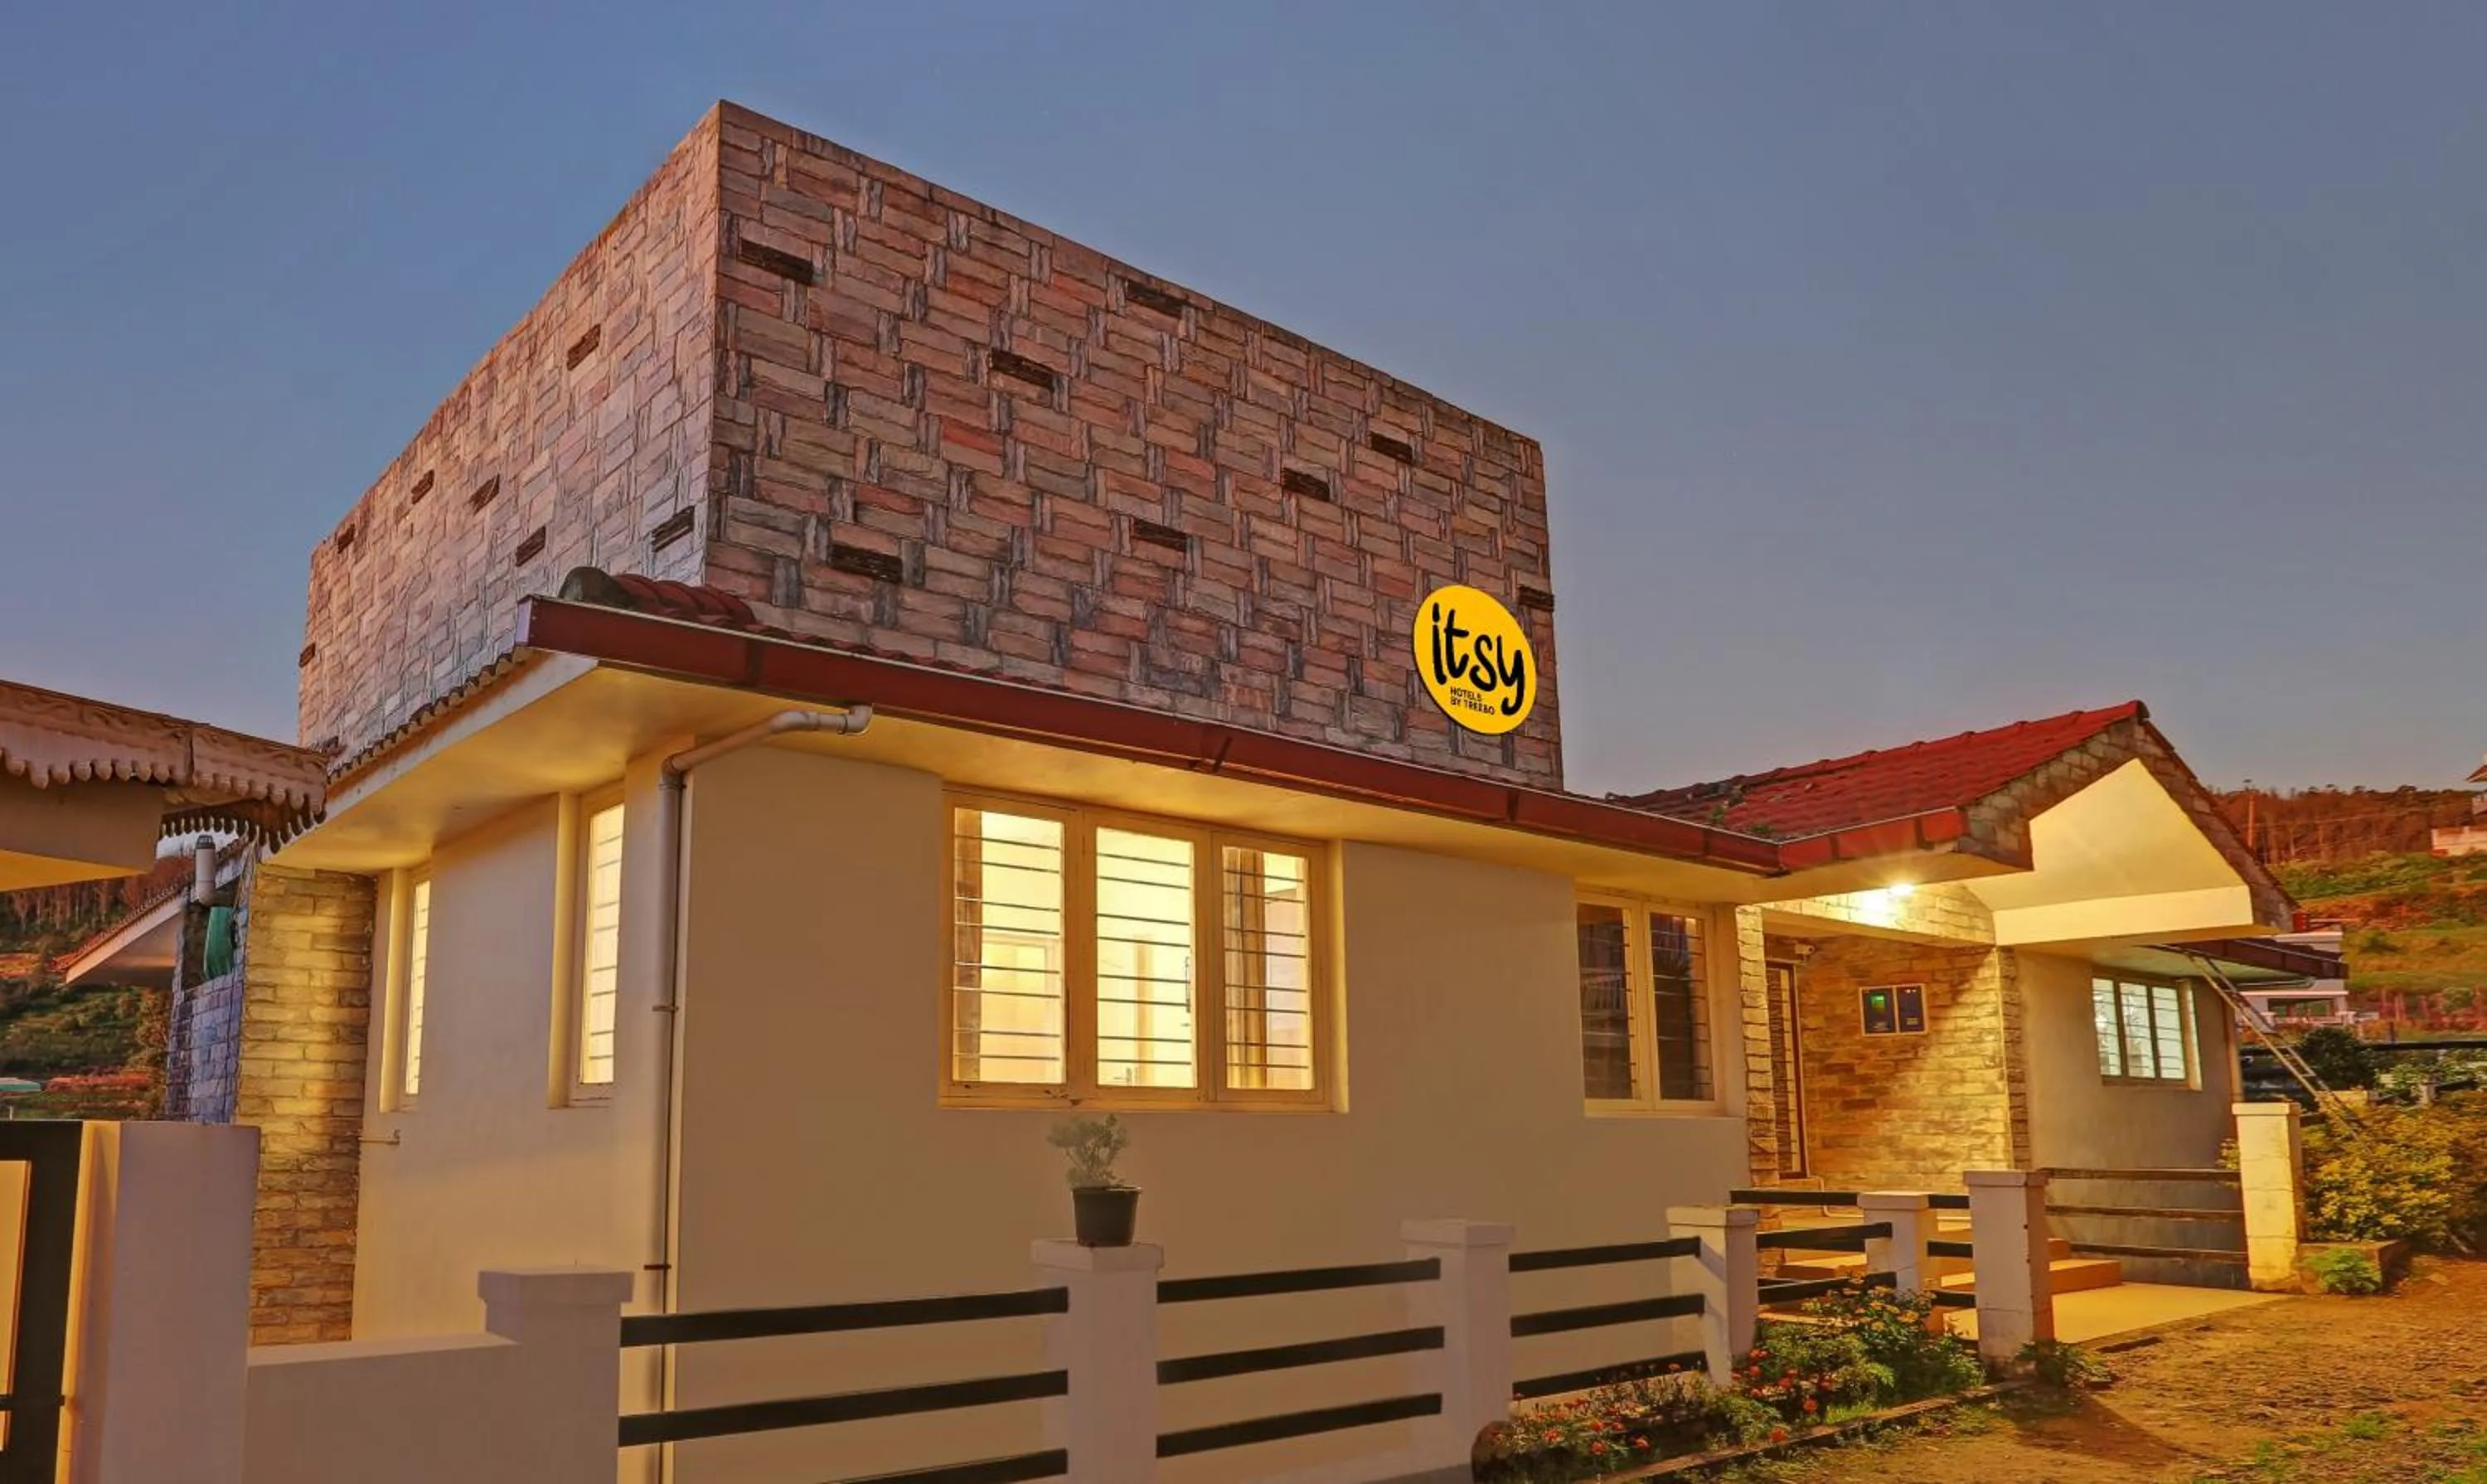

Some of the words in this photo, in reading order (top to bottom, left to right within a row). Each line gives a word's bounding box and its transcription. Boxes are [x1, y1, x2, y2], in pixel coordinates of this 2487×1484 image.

[1433, 603, 1525, 715] itsy
[1451, 686, 1482, 701] HOTELS
[1451, 696, 1462, 706] BY
